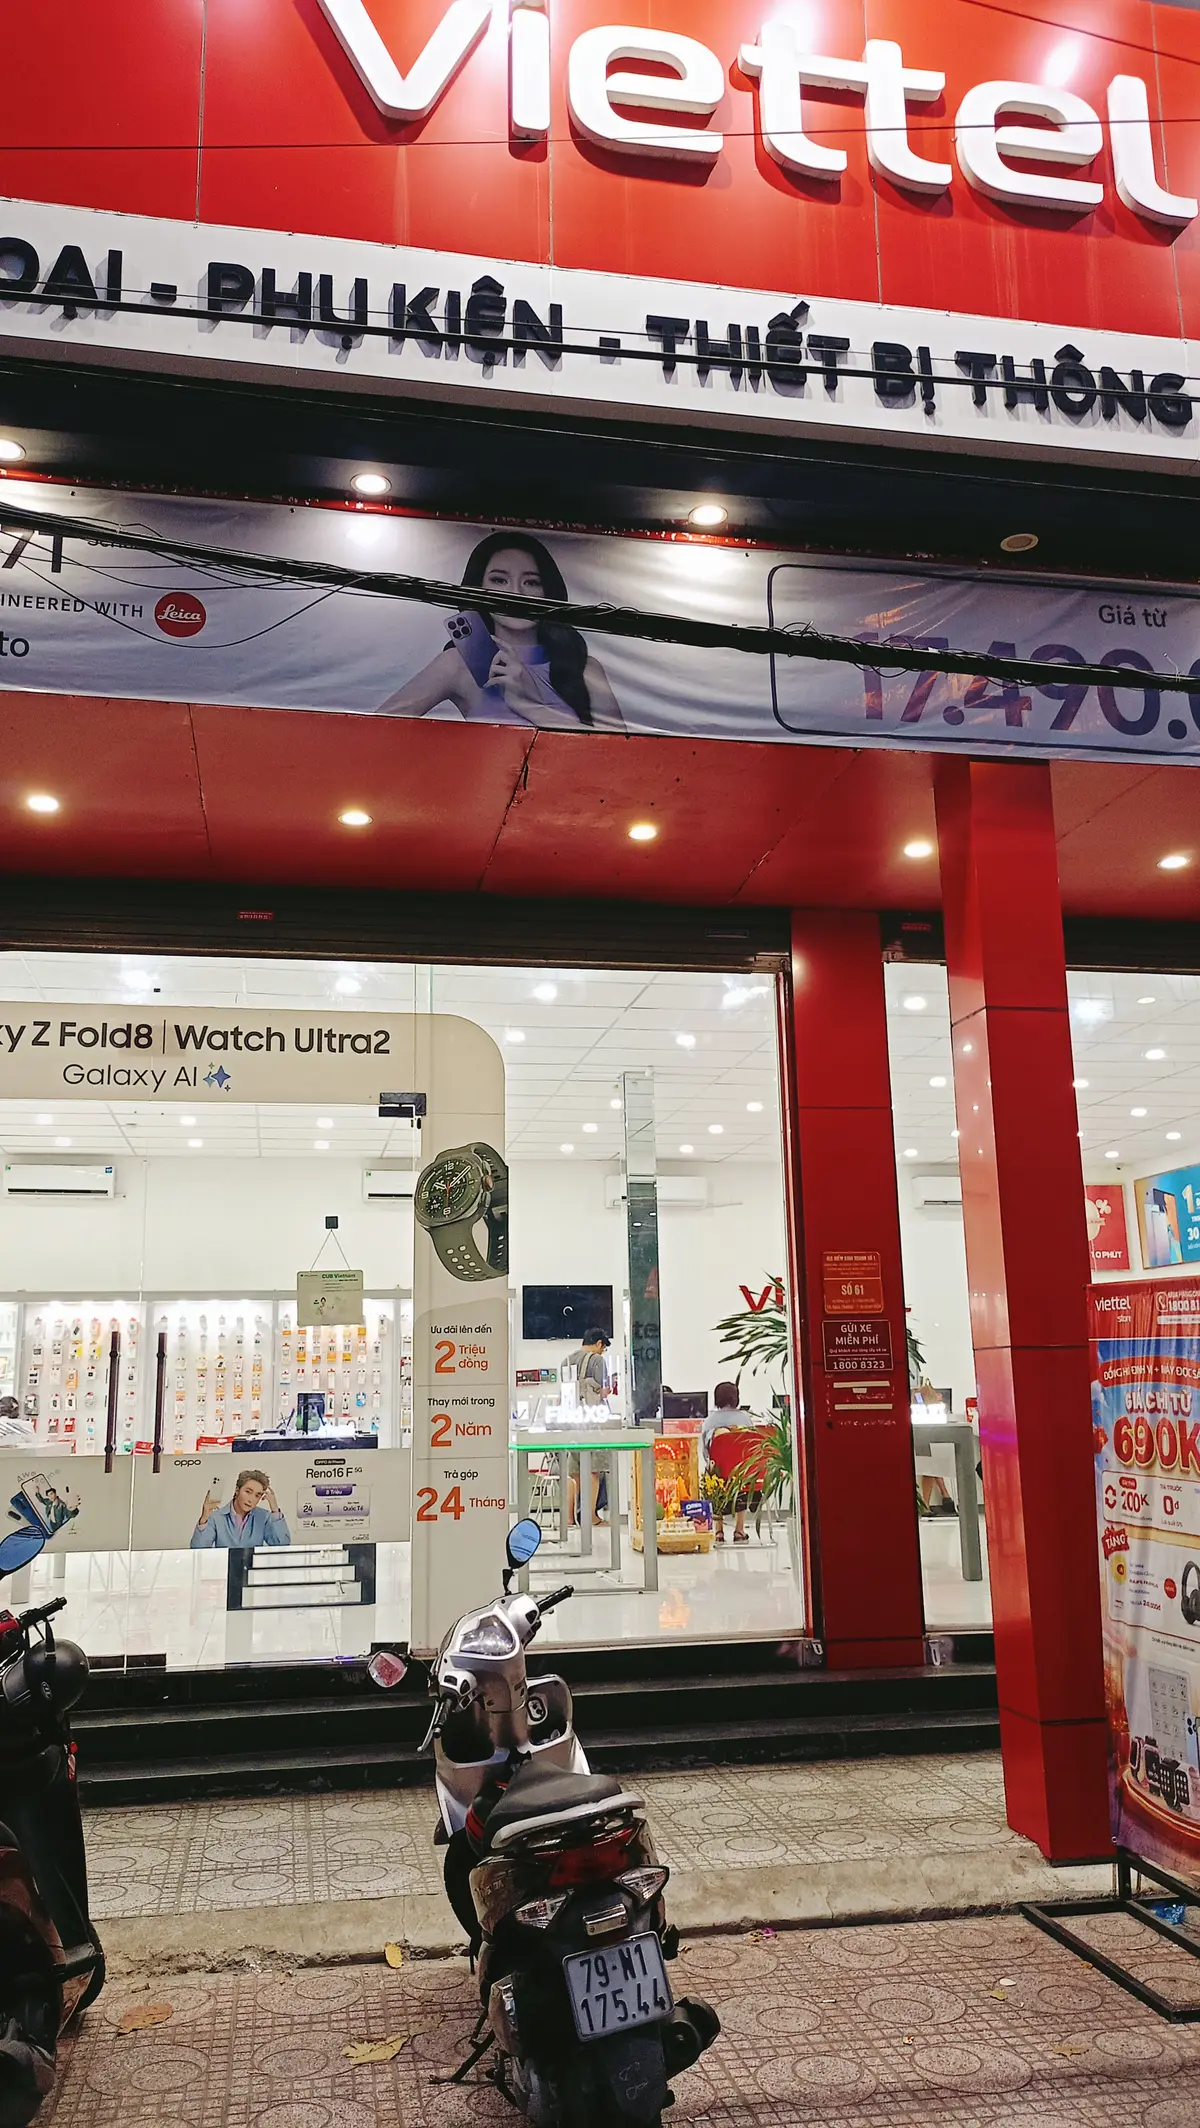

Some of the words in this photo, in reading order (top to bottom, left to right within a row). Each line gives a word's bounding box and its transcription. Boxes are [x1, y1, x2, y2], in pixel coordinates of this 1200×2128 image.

[208, 261, 368, 349] PHỤ
[393, 275, 562, 367] KIỆN
[645, 300, 850, 392] THIẾT
[872, 341, 936, 414] BỊ
[955, 343, 1192, 425] THÔNG
[95, 601, 144, 618] WITH
[157, 603, 202, 623] Leica
[1098, 604, 1136, 626] Giá
[1142, 608, 1168, 628] từ
[854, 632, 1200, 740] 17.490.
[31, 1021, 51, 1047] Z
[59, 1021, 154, 1049] Fold8
[174, 1024, 286, 1052] Watch
[294, 1027, 391, 1055] Ultra2
[62, 1063, 167, 1092] Galaxy
[174, 1065, 198, 1088] AI
[841, 1281, 853, 1296] SỐ
[854, 1284, 864, 1296] 61
[1095, 1295, 1132, 1312] viettel
[459, 1325, 473, 1334] lên
[474, 1323, 493, 1334] đến
[859, 1324, 872, 1333] XE
[862, 1334, 879, 1345] PHÍ
[434, 1340, 456, 1374] 2
[459, 1344, 486, 1357] Triệu
[458, 1356, 489, 1371] đồng
[833, 1361, 858, 1370] 1800
[860, 1361, 885, 1369] 8323
[427, 1397, 450, 1407] Thay
[452, 1396, 469, 1406] mới
[470, 1397, 496, 1407] trong
[430, 1413, 452, 1447] 2
[455, 1423, 492, 1436] Năm
[306, 1467, 344, 1478] Reno16
[346, 1467, 353, 1477] F
[443, 1470, 460, 1479] Trả
[460, 1470, 479, 1480] góp
[303, 1504, 313, 1513] 24
[416, 1486, 466, 1522] 24
[469, 1496, 506, 1510] Tháng
[580, 1977, 667, 2032] 175.44
